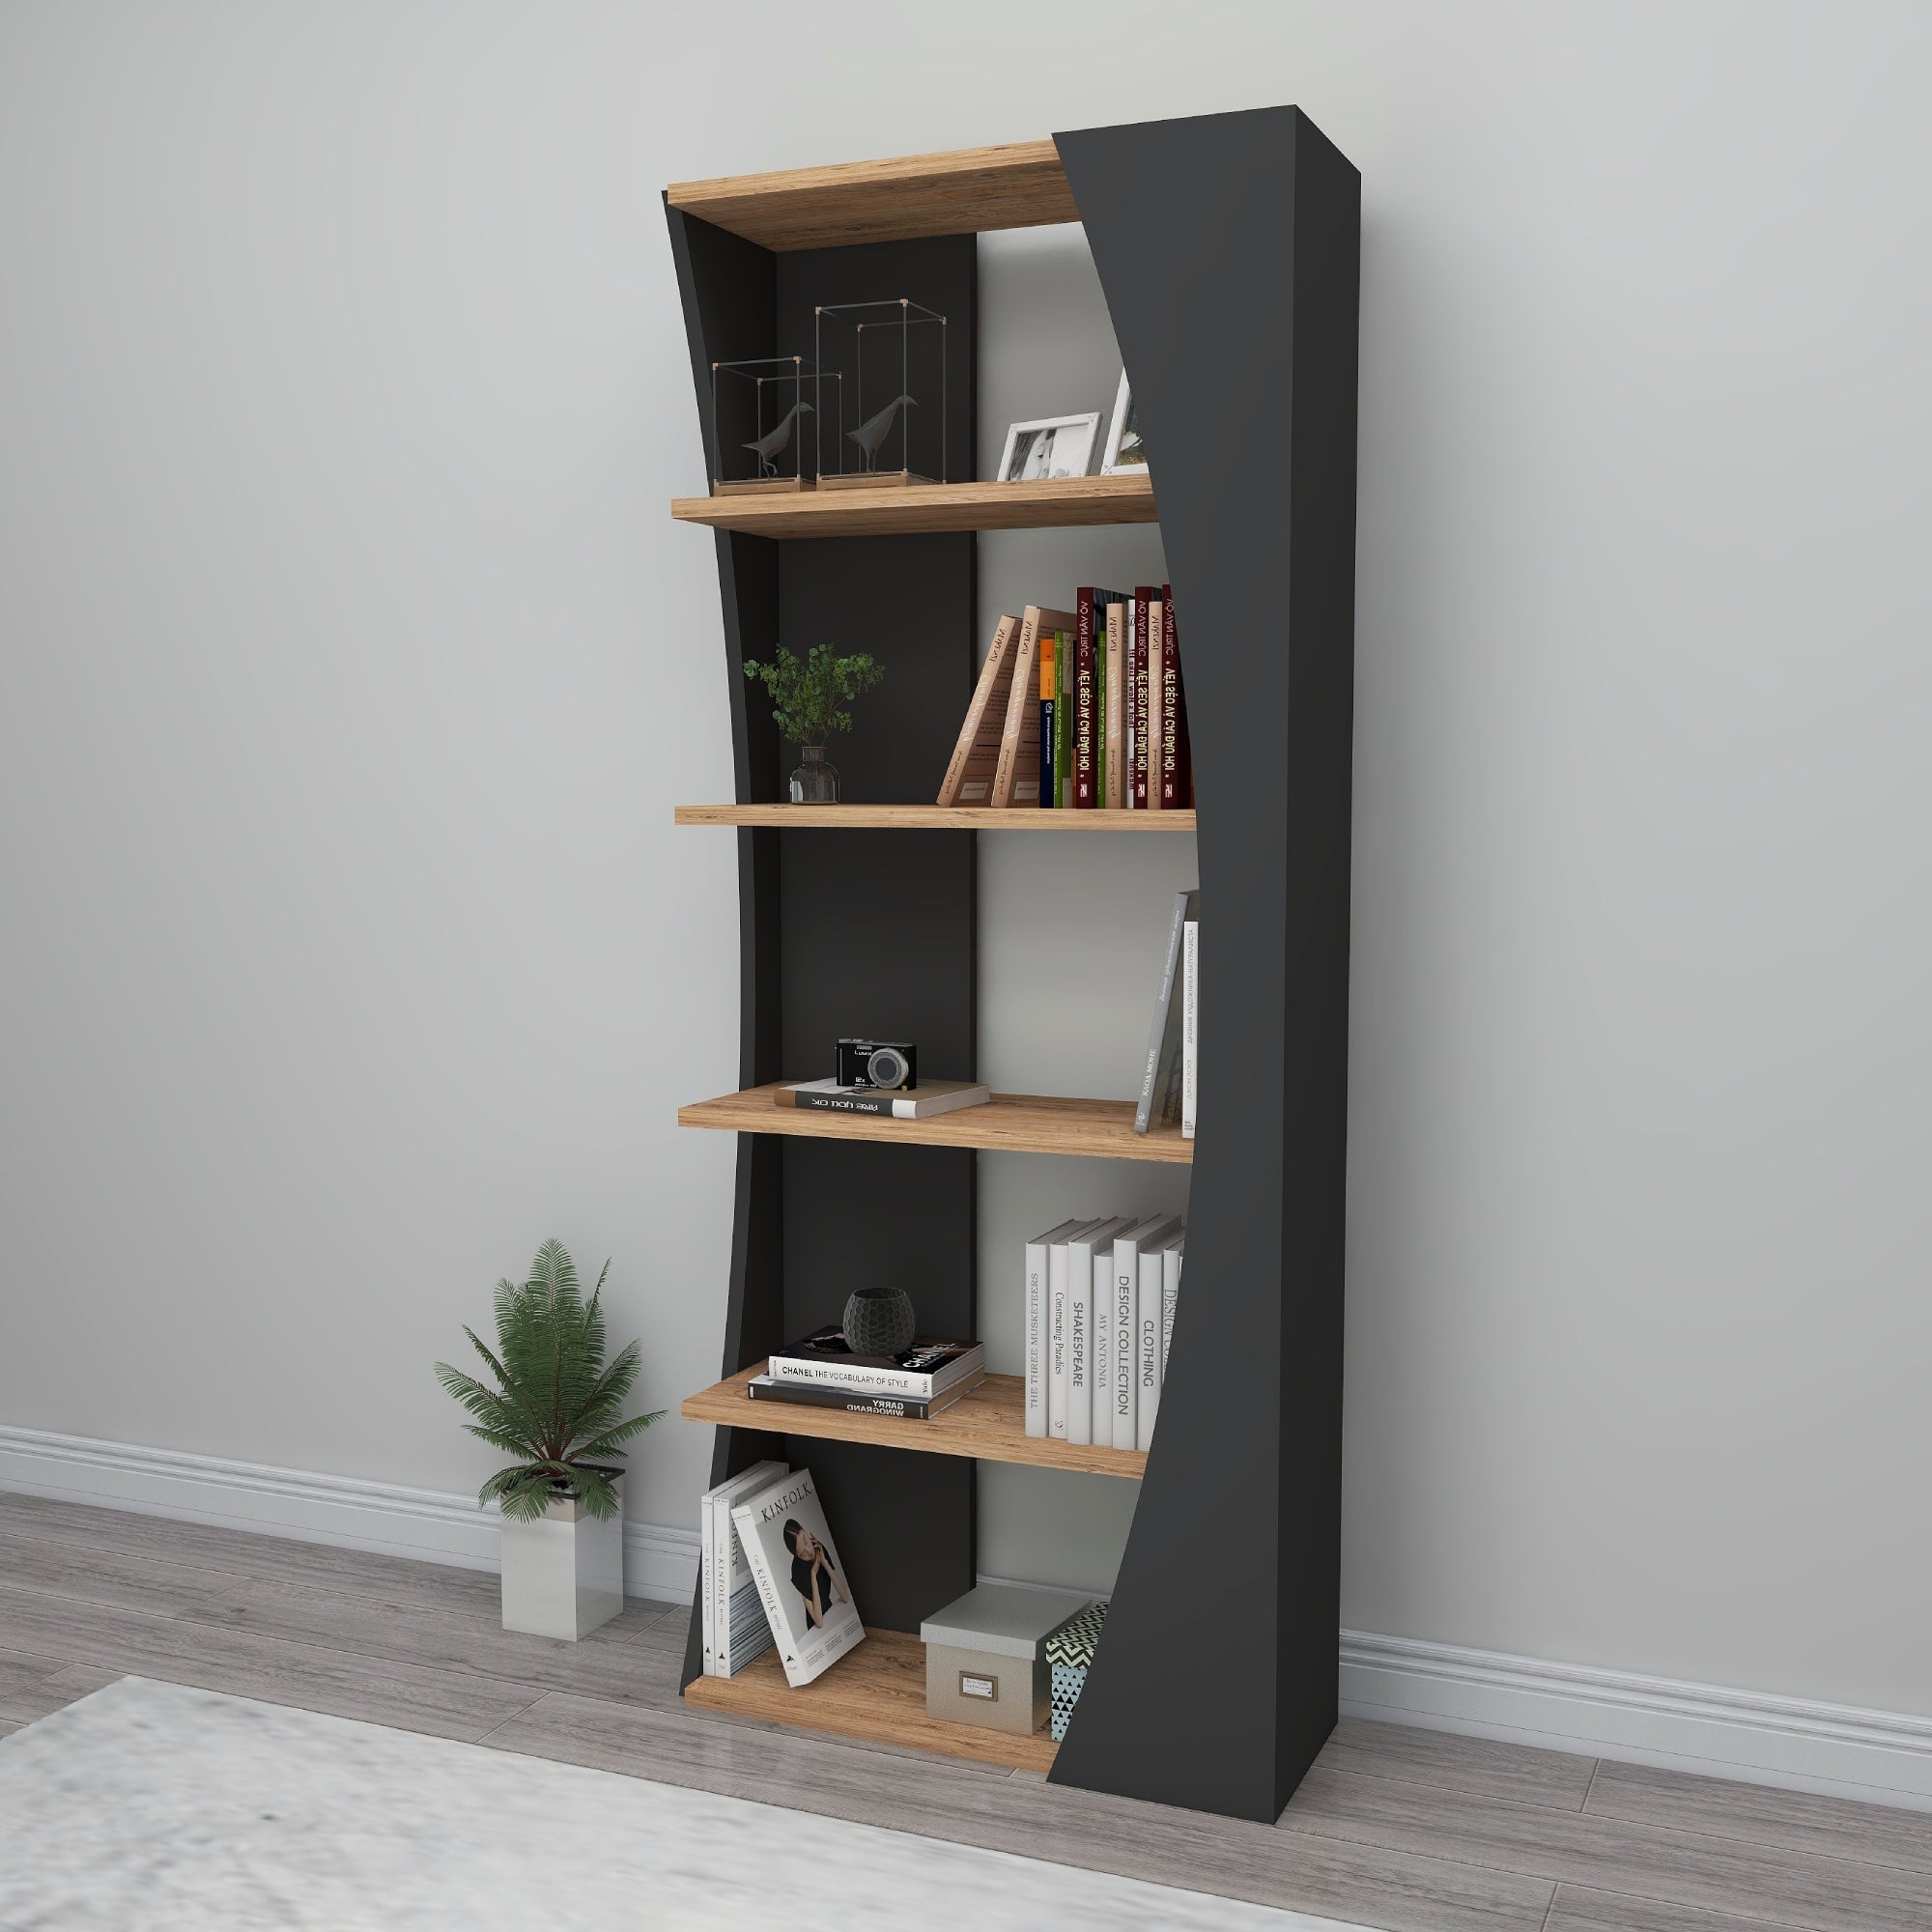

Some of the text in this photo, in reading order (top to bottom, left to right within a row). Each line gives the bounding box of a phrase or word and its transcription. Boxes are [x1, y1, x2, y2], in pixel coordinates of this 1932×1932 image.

[1053, 1292, 1065, 1340] Constructing
[1098, 1314, 1107, 1331] MY
[1072, 1302, 1084, 1387] SHAKESPEARE
[1118, 1275, 1129, 1415] DESIGN COLLECTION
[1143, 1320, 1154, 1387] CLOTHING
[781, 1366, 813, 1378] CHANEL
[814, 1370, 828, 1378] THE
[829, 1372, 874, 1384] VOCABULARY
[876, 1377, 886, 1385] OF
[887, 1378, 909, 1388] STYLE
[1030, 1388, 1038, 1409] THE
[760, 1482, 812, 1523] KINFOLK
[756, 1568, 778, 1612] KINFOLK
